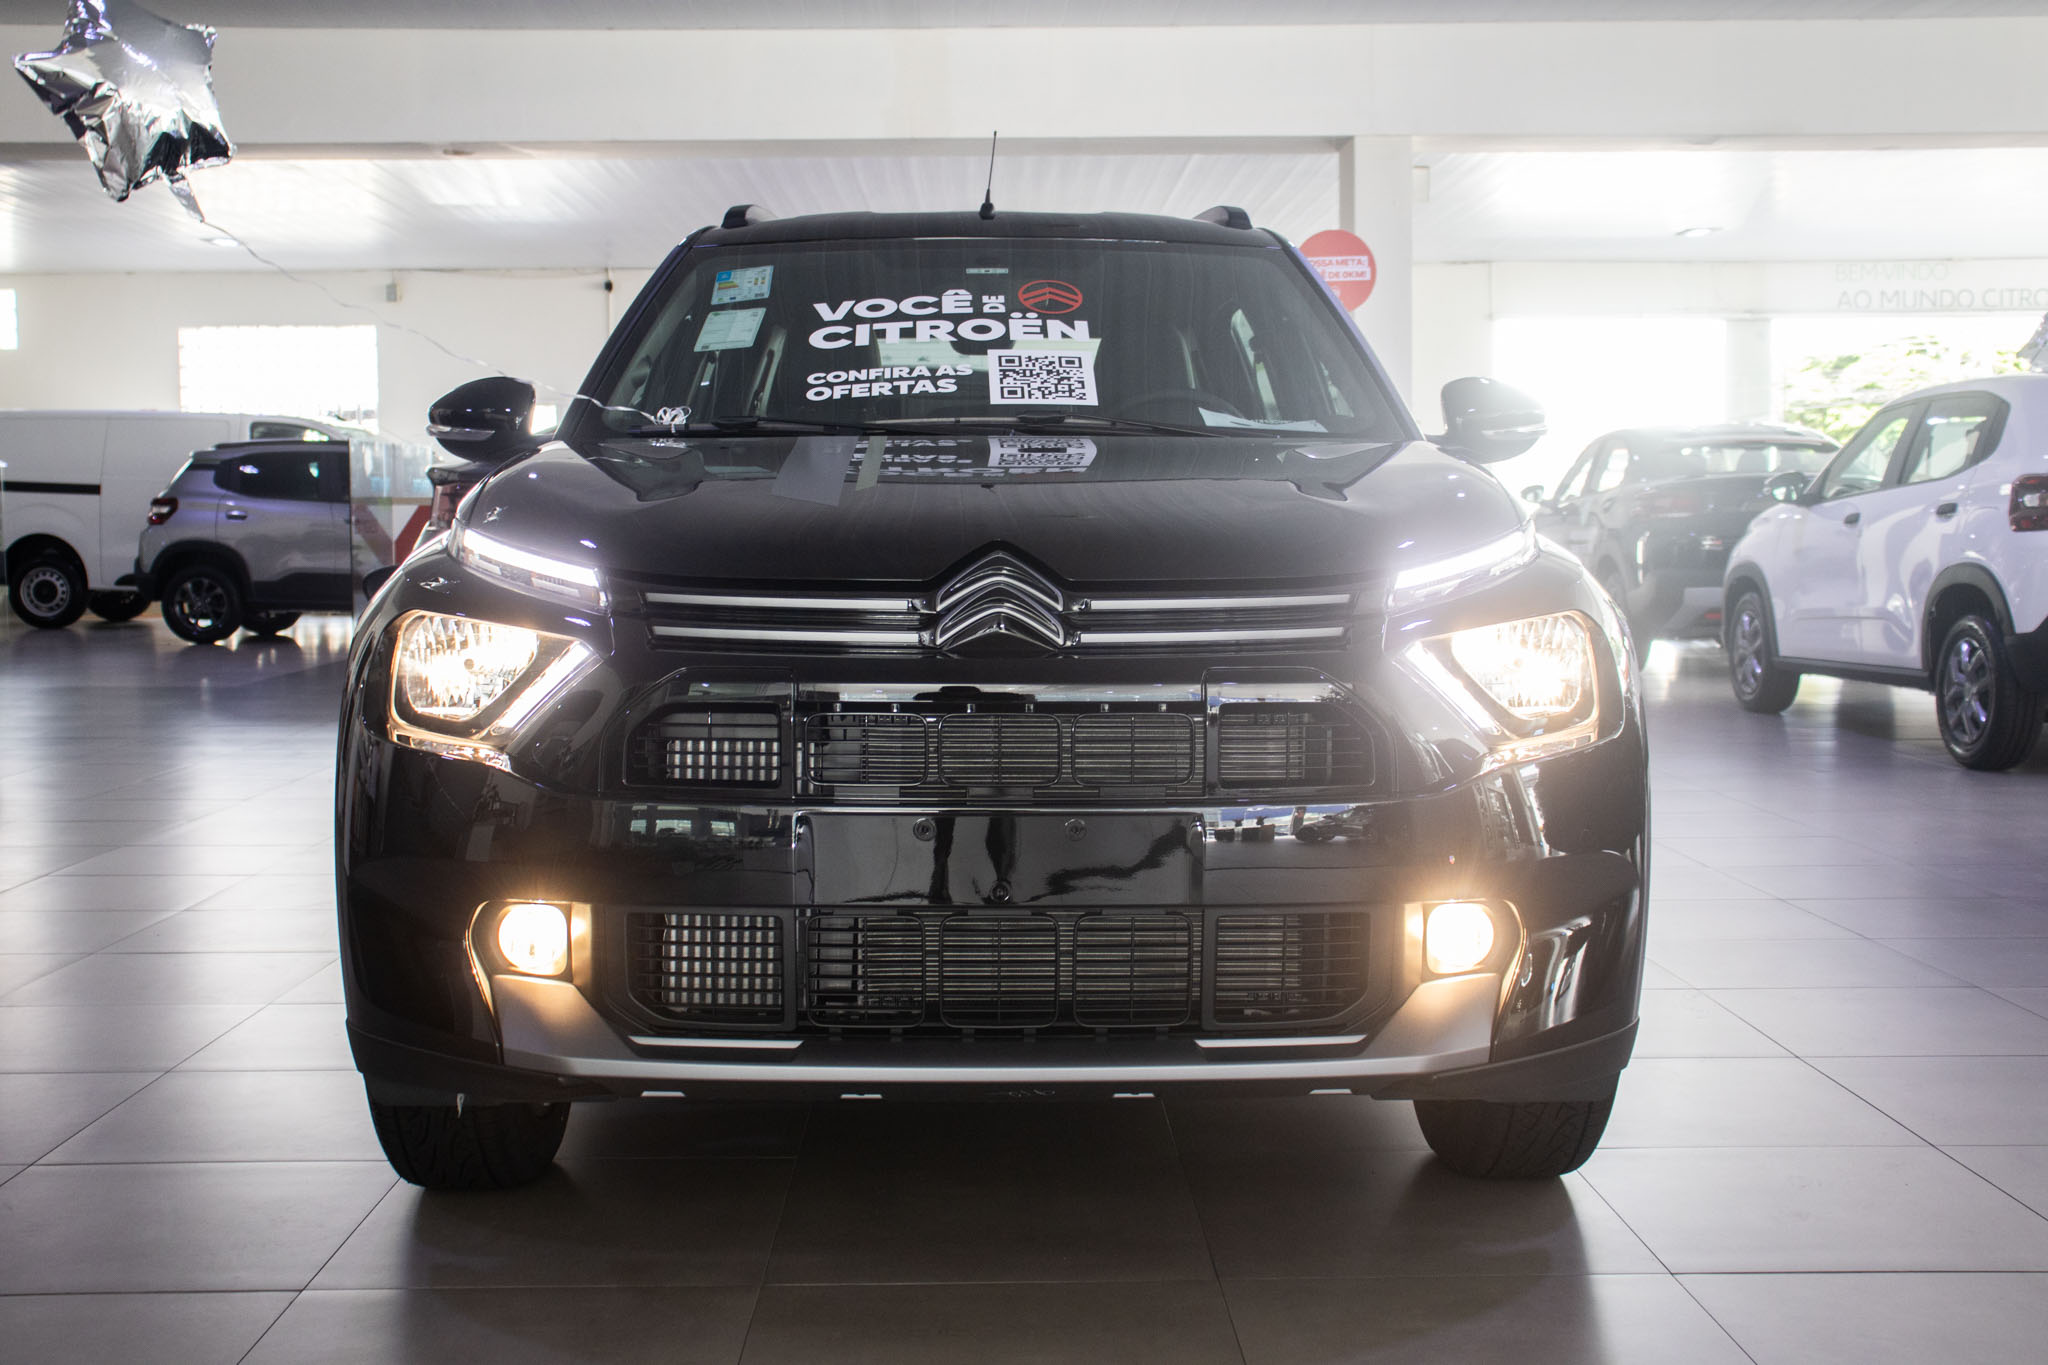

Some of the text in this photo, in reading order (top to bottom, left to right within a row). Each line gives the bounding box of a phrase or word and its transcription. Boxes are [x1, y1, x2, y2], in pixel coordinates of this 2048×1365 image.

[813, 289, 1006, 322] VOCÊ DE
[1837, 289, 1873, 309] AO
[1879, 288, 1976, 308] MUNDO
[808, 312, 1090, 350] CITROËN
[806, 364, 974, 385] CONFIRA AS
[805, 378, 958, 402] OFERTAS
